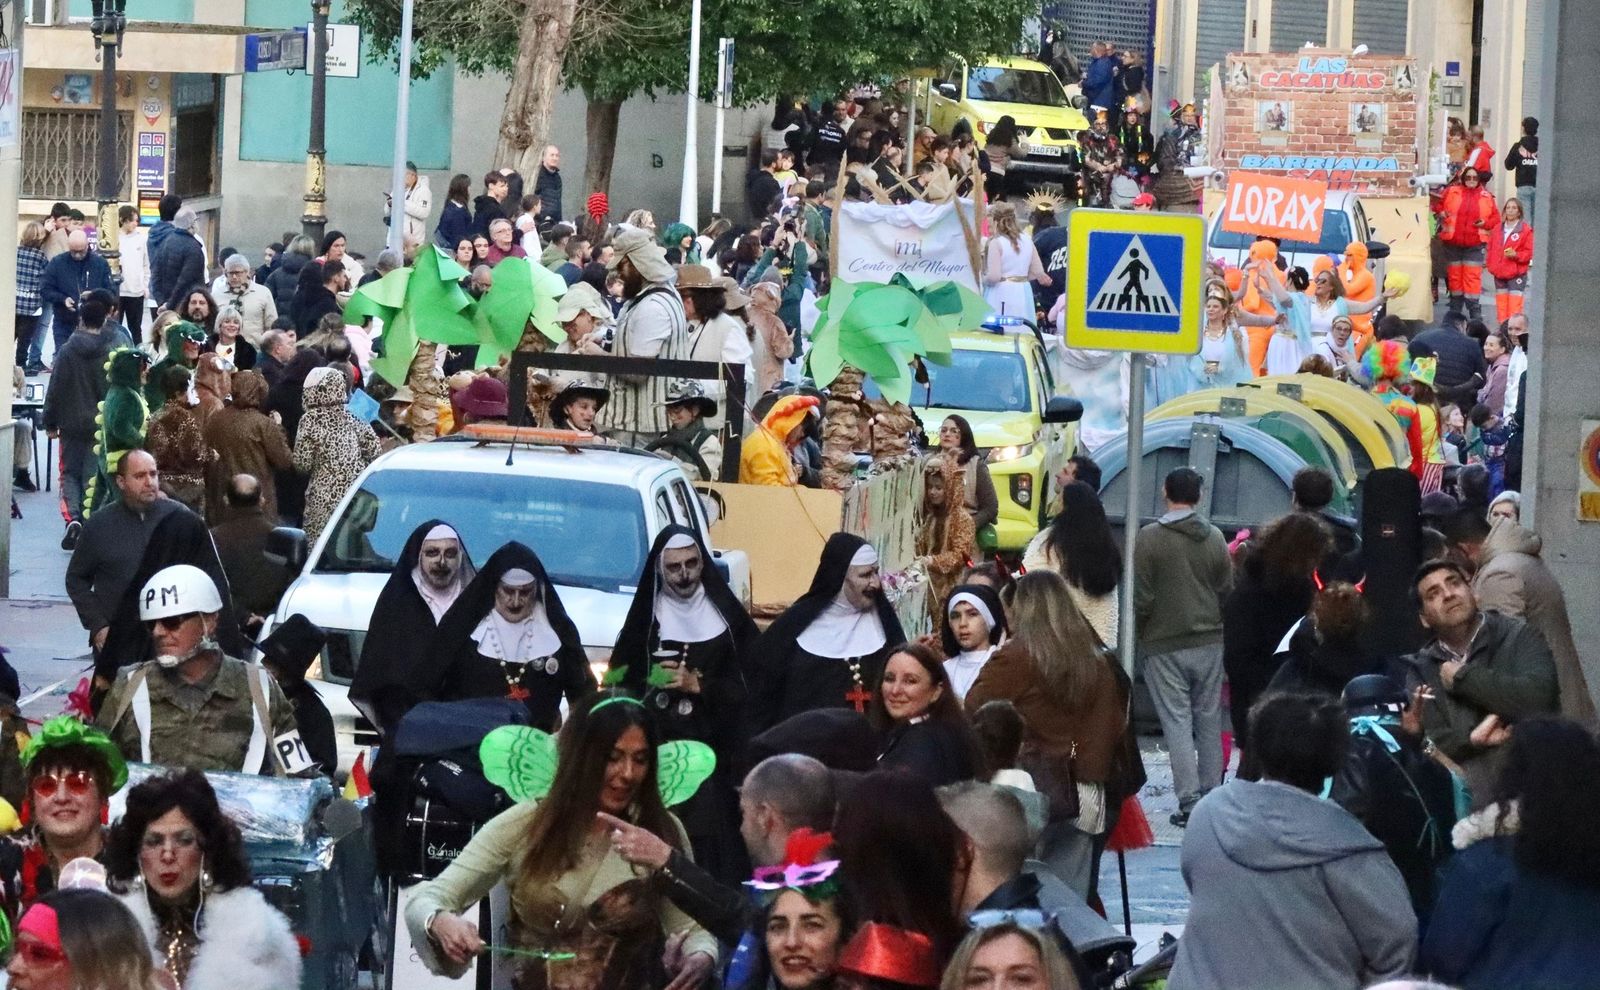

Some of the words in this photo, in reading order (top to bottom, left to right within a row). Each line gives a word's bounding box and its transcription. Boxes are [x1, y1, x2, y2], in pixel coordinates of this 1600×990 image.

[1299, 58, 1347, 73] LAS
[1259, 72, 1384, 88] CACATÚAS
[1240, 156, 1398, 170] BARRIADA
[1229, 183, 1322, 232] LORAX
[849, 258, 893, 273] Centro
[896, 261, 917, 272] del
[918, 259, 968, 276] Mayor
